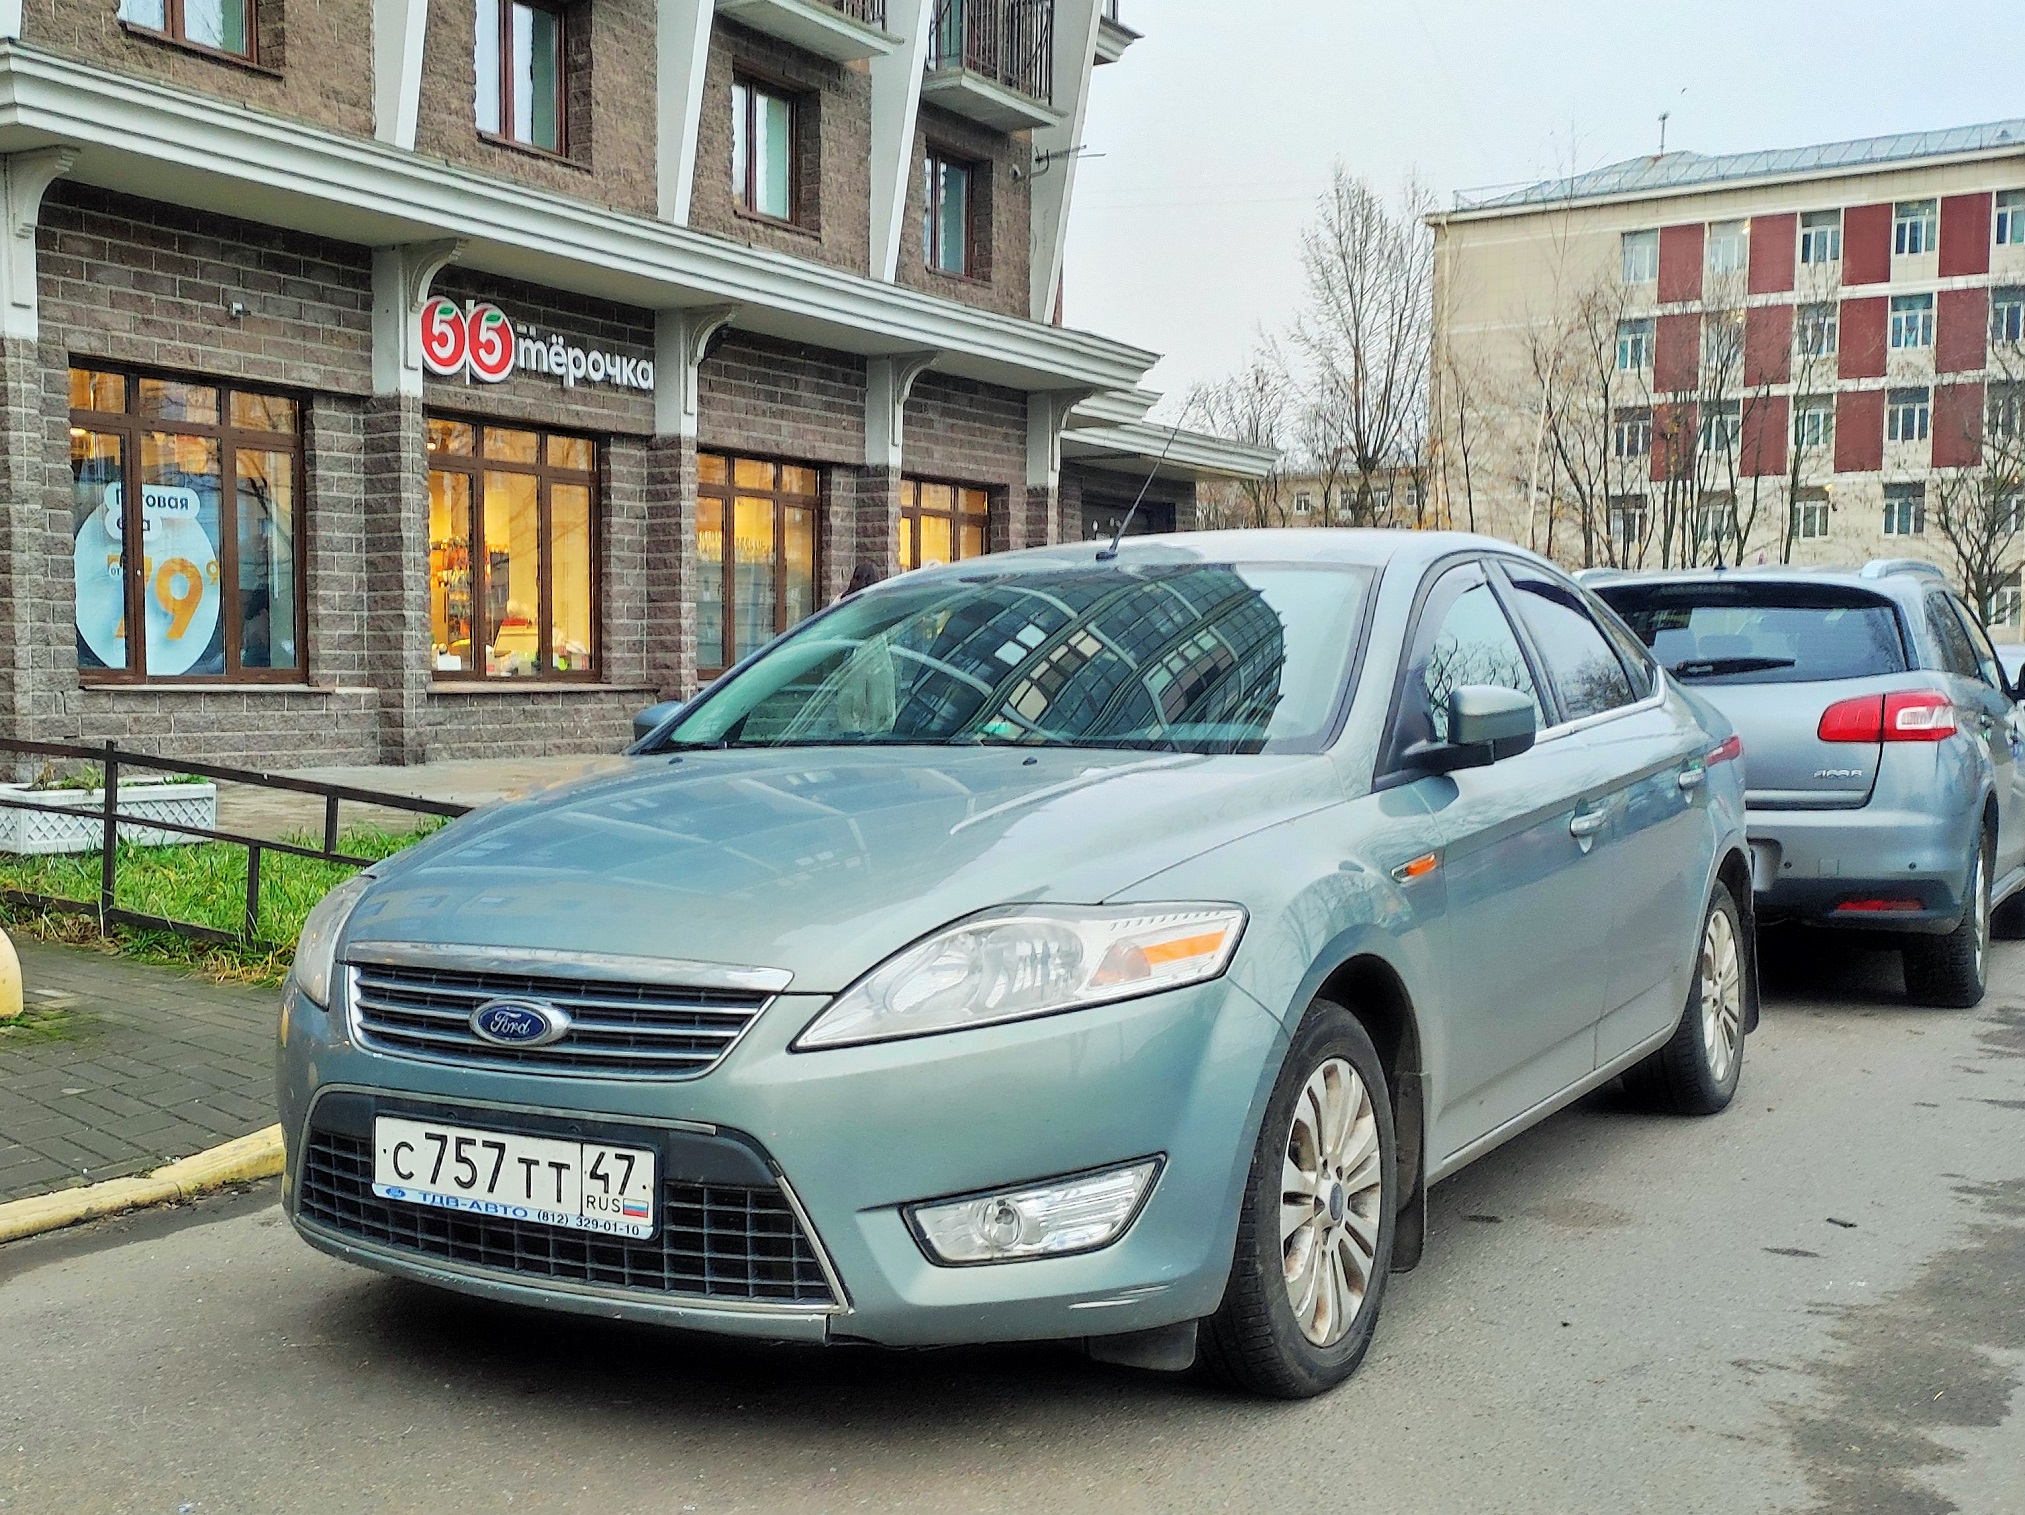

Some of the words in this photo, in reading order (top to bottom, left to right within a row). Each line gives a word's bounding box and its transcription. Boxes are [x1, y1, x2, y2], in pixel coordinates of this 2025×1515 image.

[116, 488, 189, 511] Говая
[490, 1011, 531, 1035] Ford
[589, 1152, 636, 1196] 47
[418, 1191, 528, 1218] ТДВ-АВТО
[537, 1209, 569, 1225] (812)
[576, 1216, 640, 1236] 329-01-10
[587, 1195, 621, 1213] RUS
